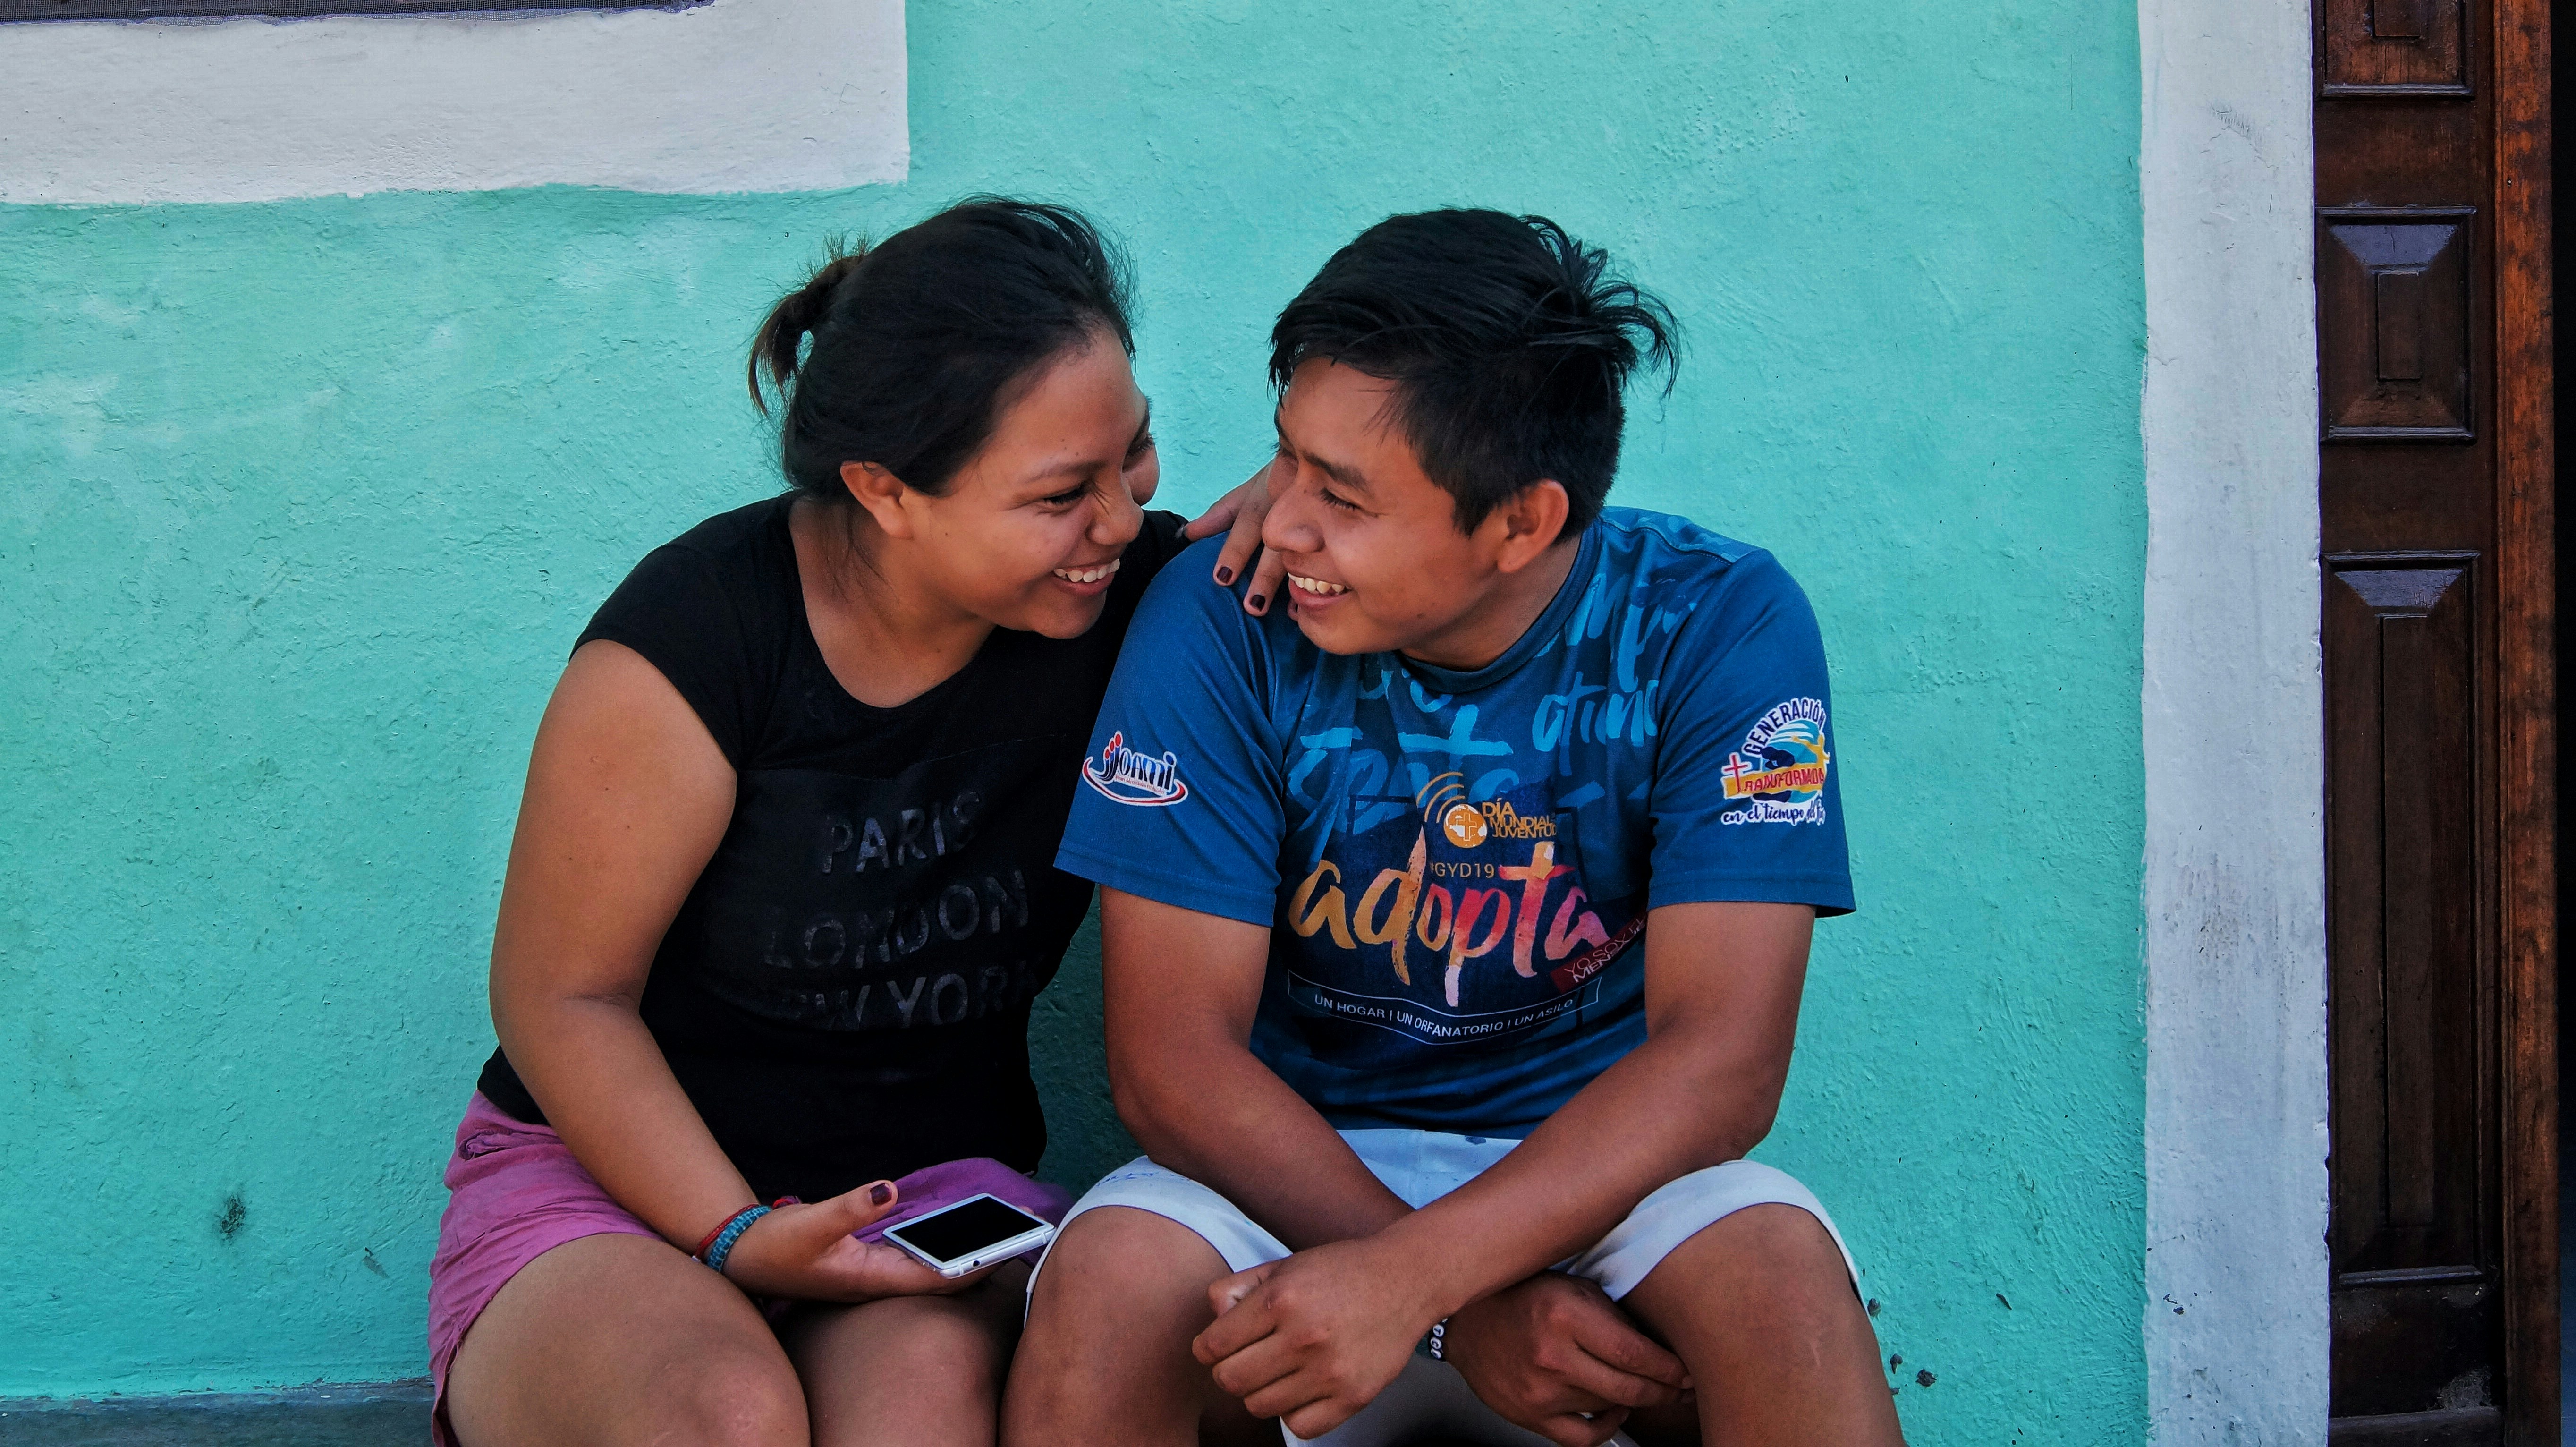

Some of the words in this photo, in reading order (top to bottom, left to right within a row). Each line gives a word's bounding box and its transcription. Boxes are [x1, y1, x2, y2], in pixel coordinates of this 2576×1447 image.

[1482, 798, 1516, 820] DÍA
[1490, 815, 1550, 829] MUNDIAL
[1723, 811, 1743, 823] en
[1747, 805, 1760, 819] el
[1763, 803, 1804, 825] tiempo
[822, 791, 980, 874] PARIS
[763, 869, 1030, 970] LONDON
[1288, 825, 1611, 1007] adopta
[1314, 994, 1333, 1009] UN
[1337, 1002, 1385, 1018] HOGAR
[1397, 1011, 1413, 1026] UN
[1415, 1017, 1503, 1037] ORFANATORIO
[1514, 1013, 1534, 1027] UN
[1536, 999, 1573, 1019] ASILO
